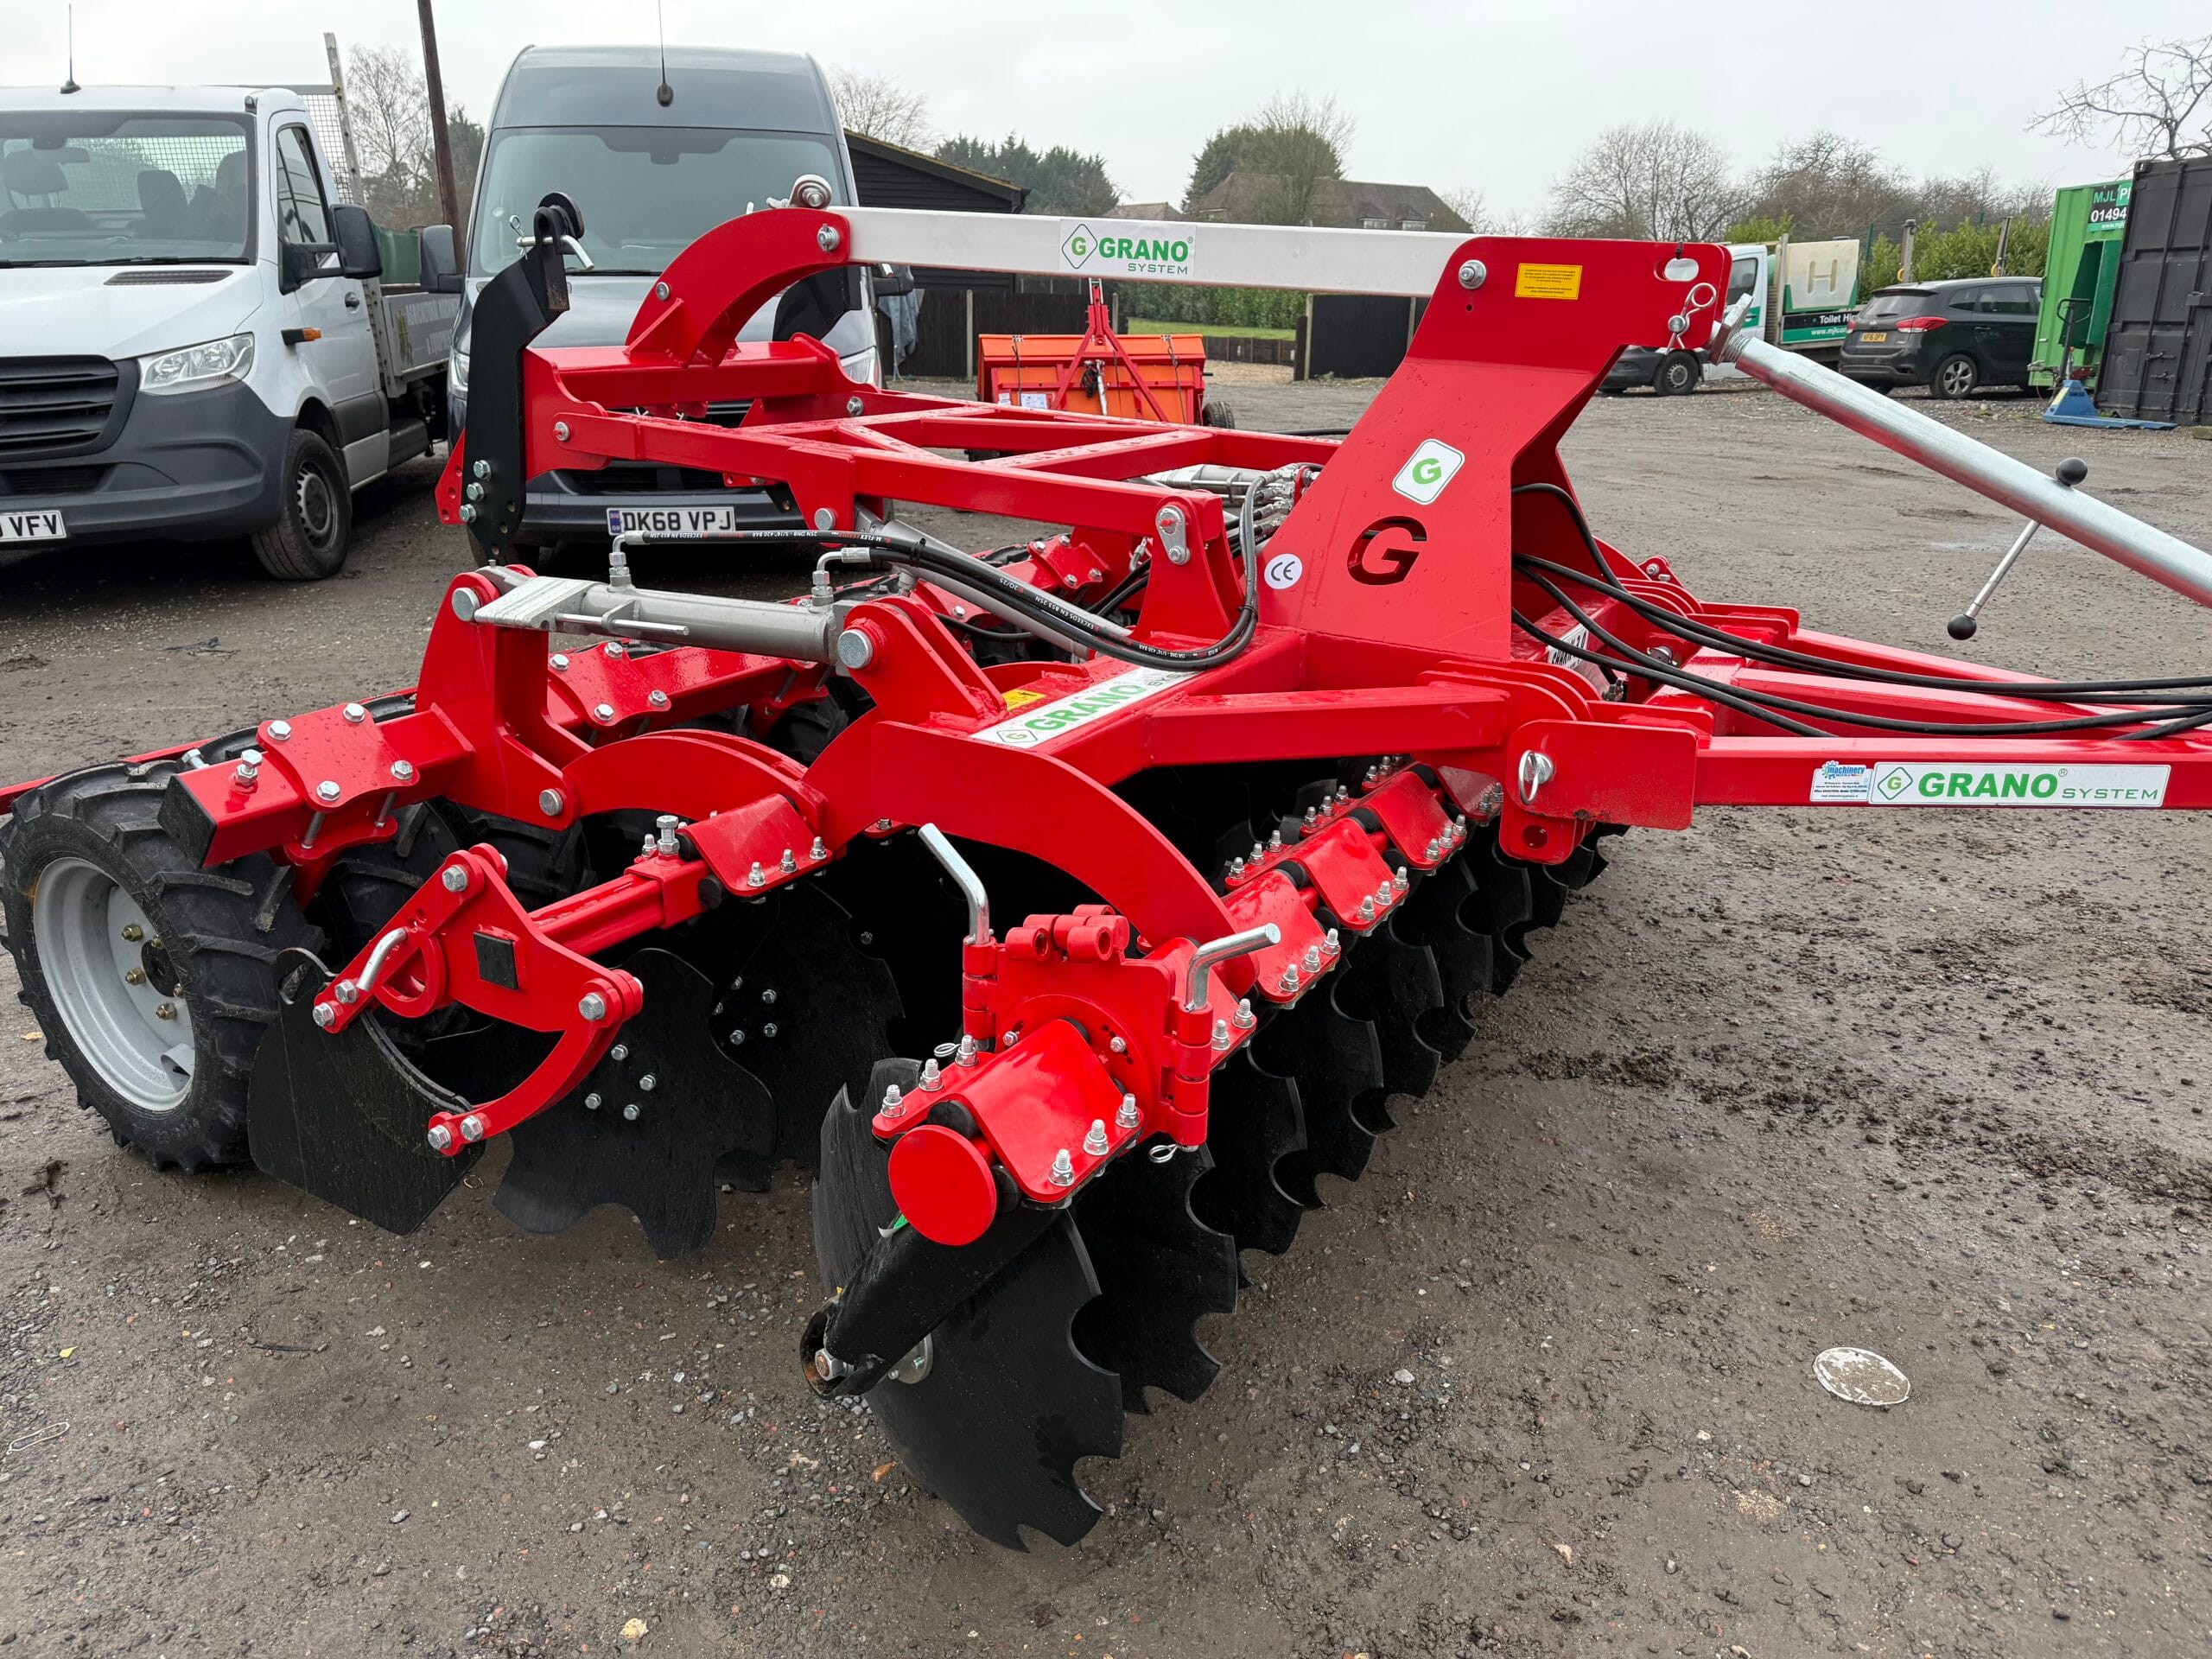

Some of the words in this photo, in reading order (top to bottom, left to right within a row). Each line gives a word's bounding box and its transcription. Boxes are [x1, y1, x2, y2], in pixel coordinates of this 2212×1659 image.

[2093, 190, 2116, 204] MJL
[2090, 207, 2126, 222] 01494
[1127, 263, 1188, 275] SYSTEM
[1819, 315, 1842, 325] Toilet
[8, 514, 57, 537] VFV
[621, 511, 682, 531] DK68
[688, 510, 732, 531] VPJ
[1034, 595, 1048, 606] 2SN
[1059, 607, 1069, 617] EN
[1069, 613, 1095, 630] EXCEEDS
[1827, 766, 1866, 775] machinery
[2061, 787, 2158, 800] SYSTEM
